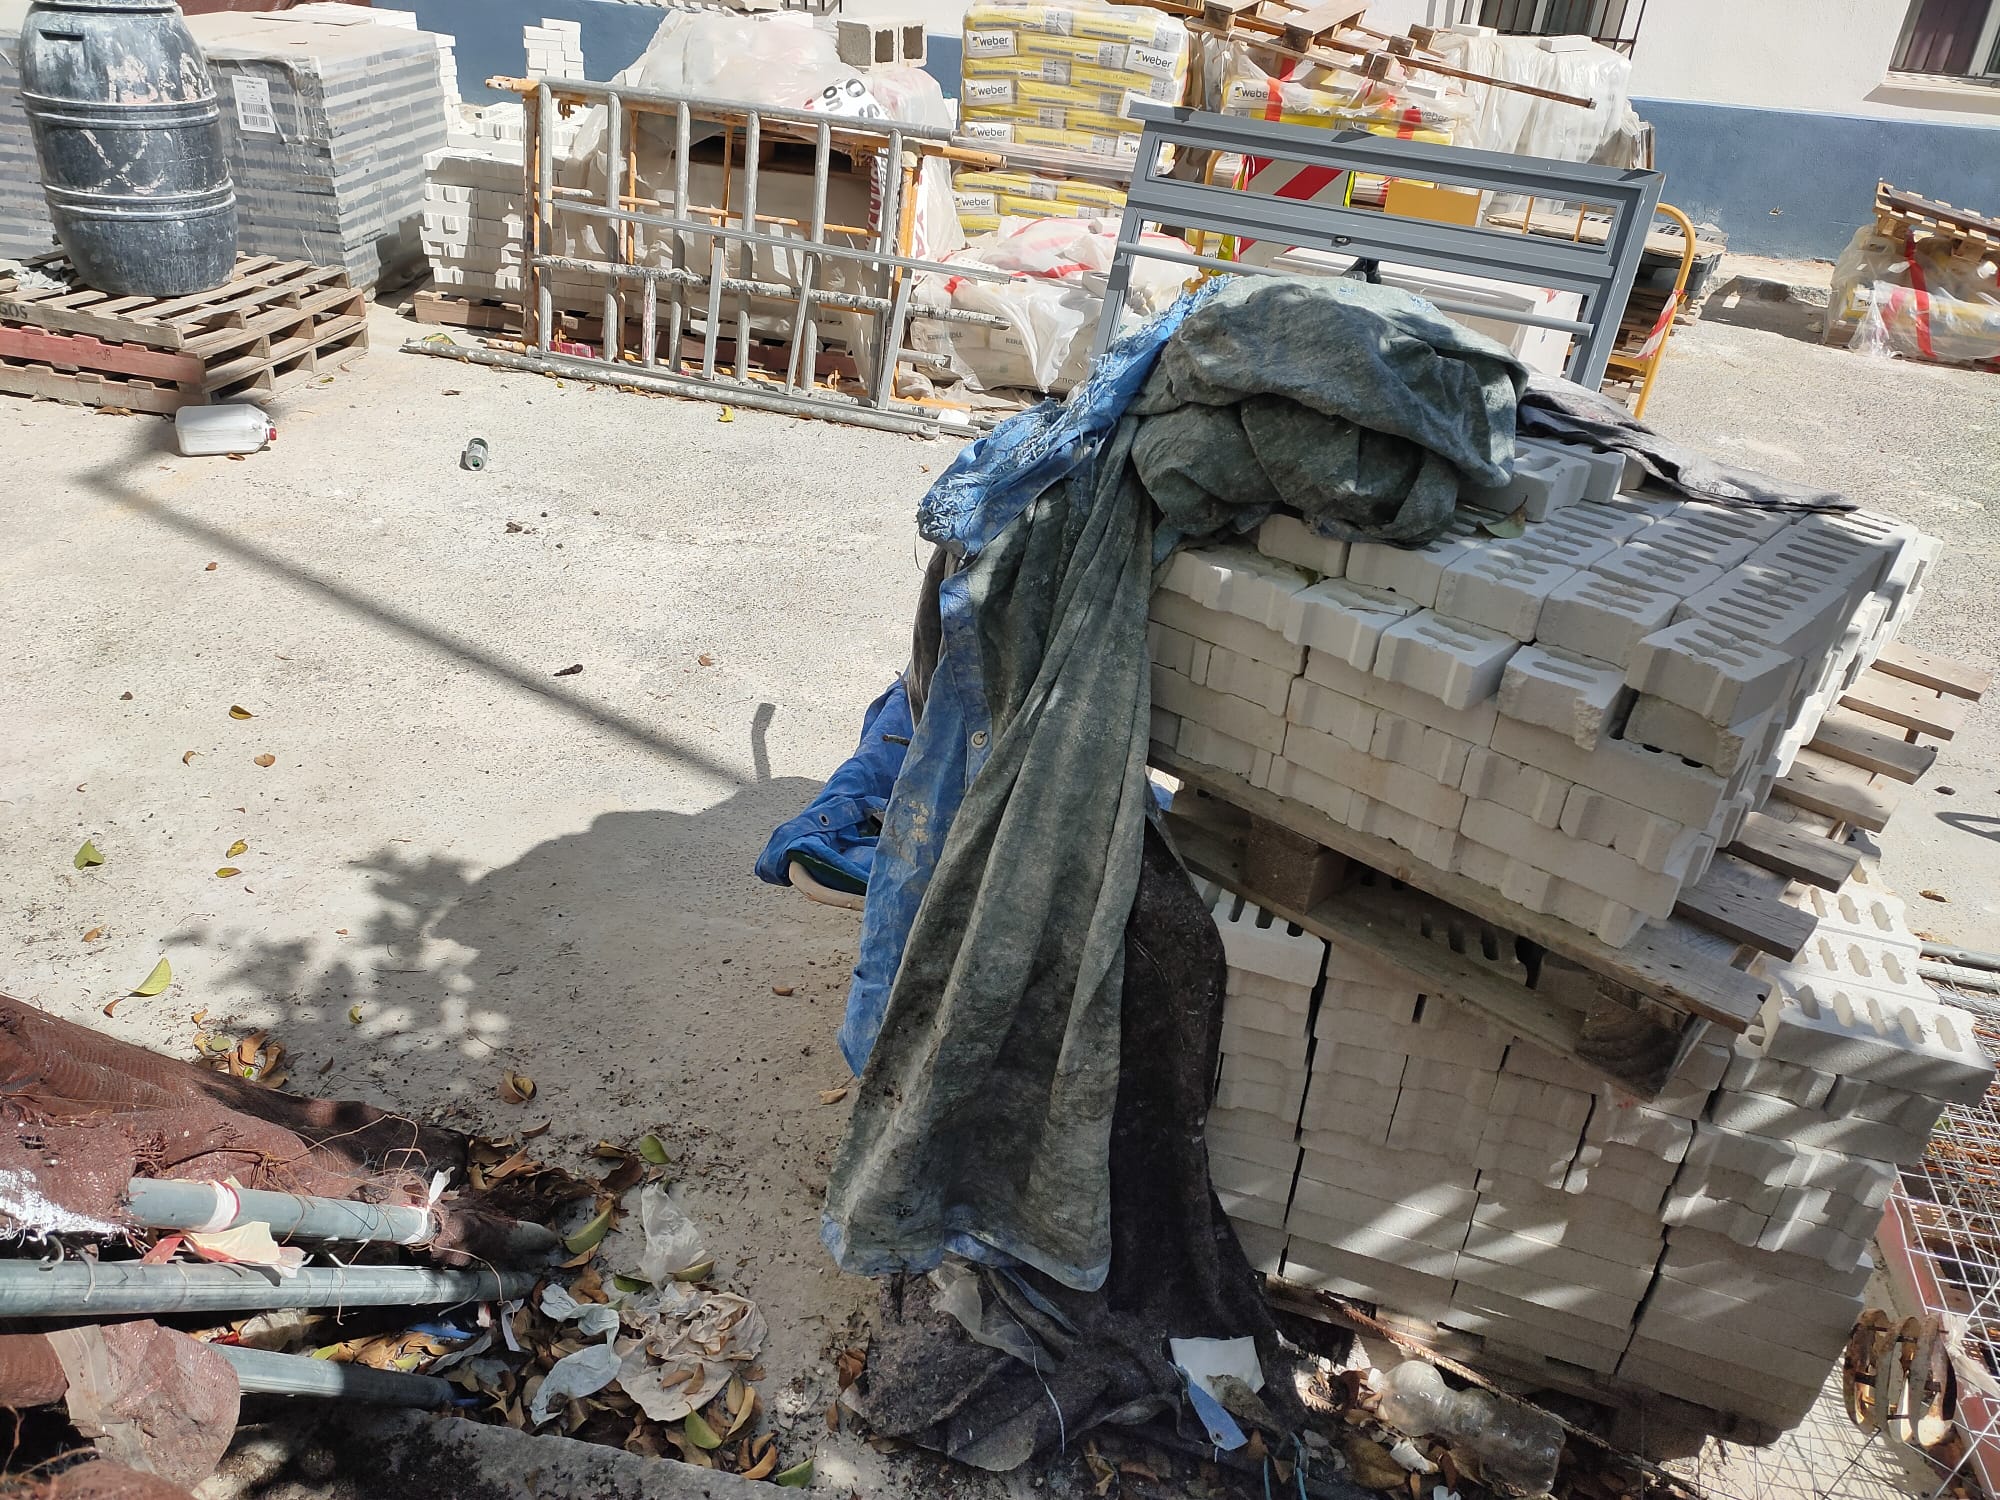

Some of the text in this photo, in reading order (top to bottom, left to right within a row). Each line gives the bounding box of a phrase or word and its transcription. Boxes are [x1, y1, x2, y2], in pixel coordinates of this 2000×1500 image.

[979, 35, 1009, 46] weber
[1142, 53, 1173, 69] weber
[977, 83, 1007, 95] weber
[1242, 88, 1269, 98] webe
[976, 127, 1007, 138] weber
[961, 197, 991, 207] weber
